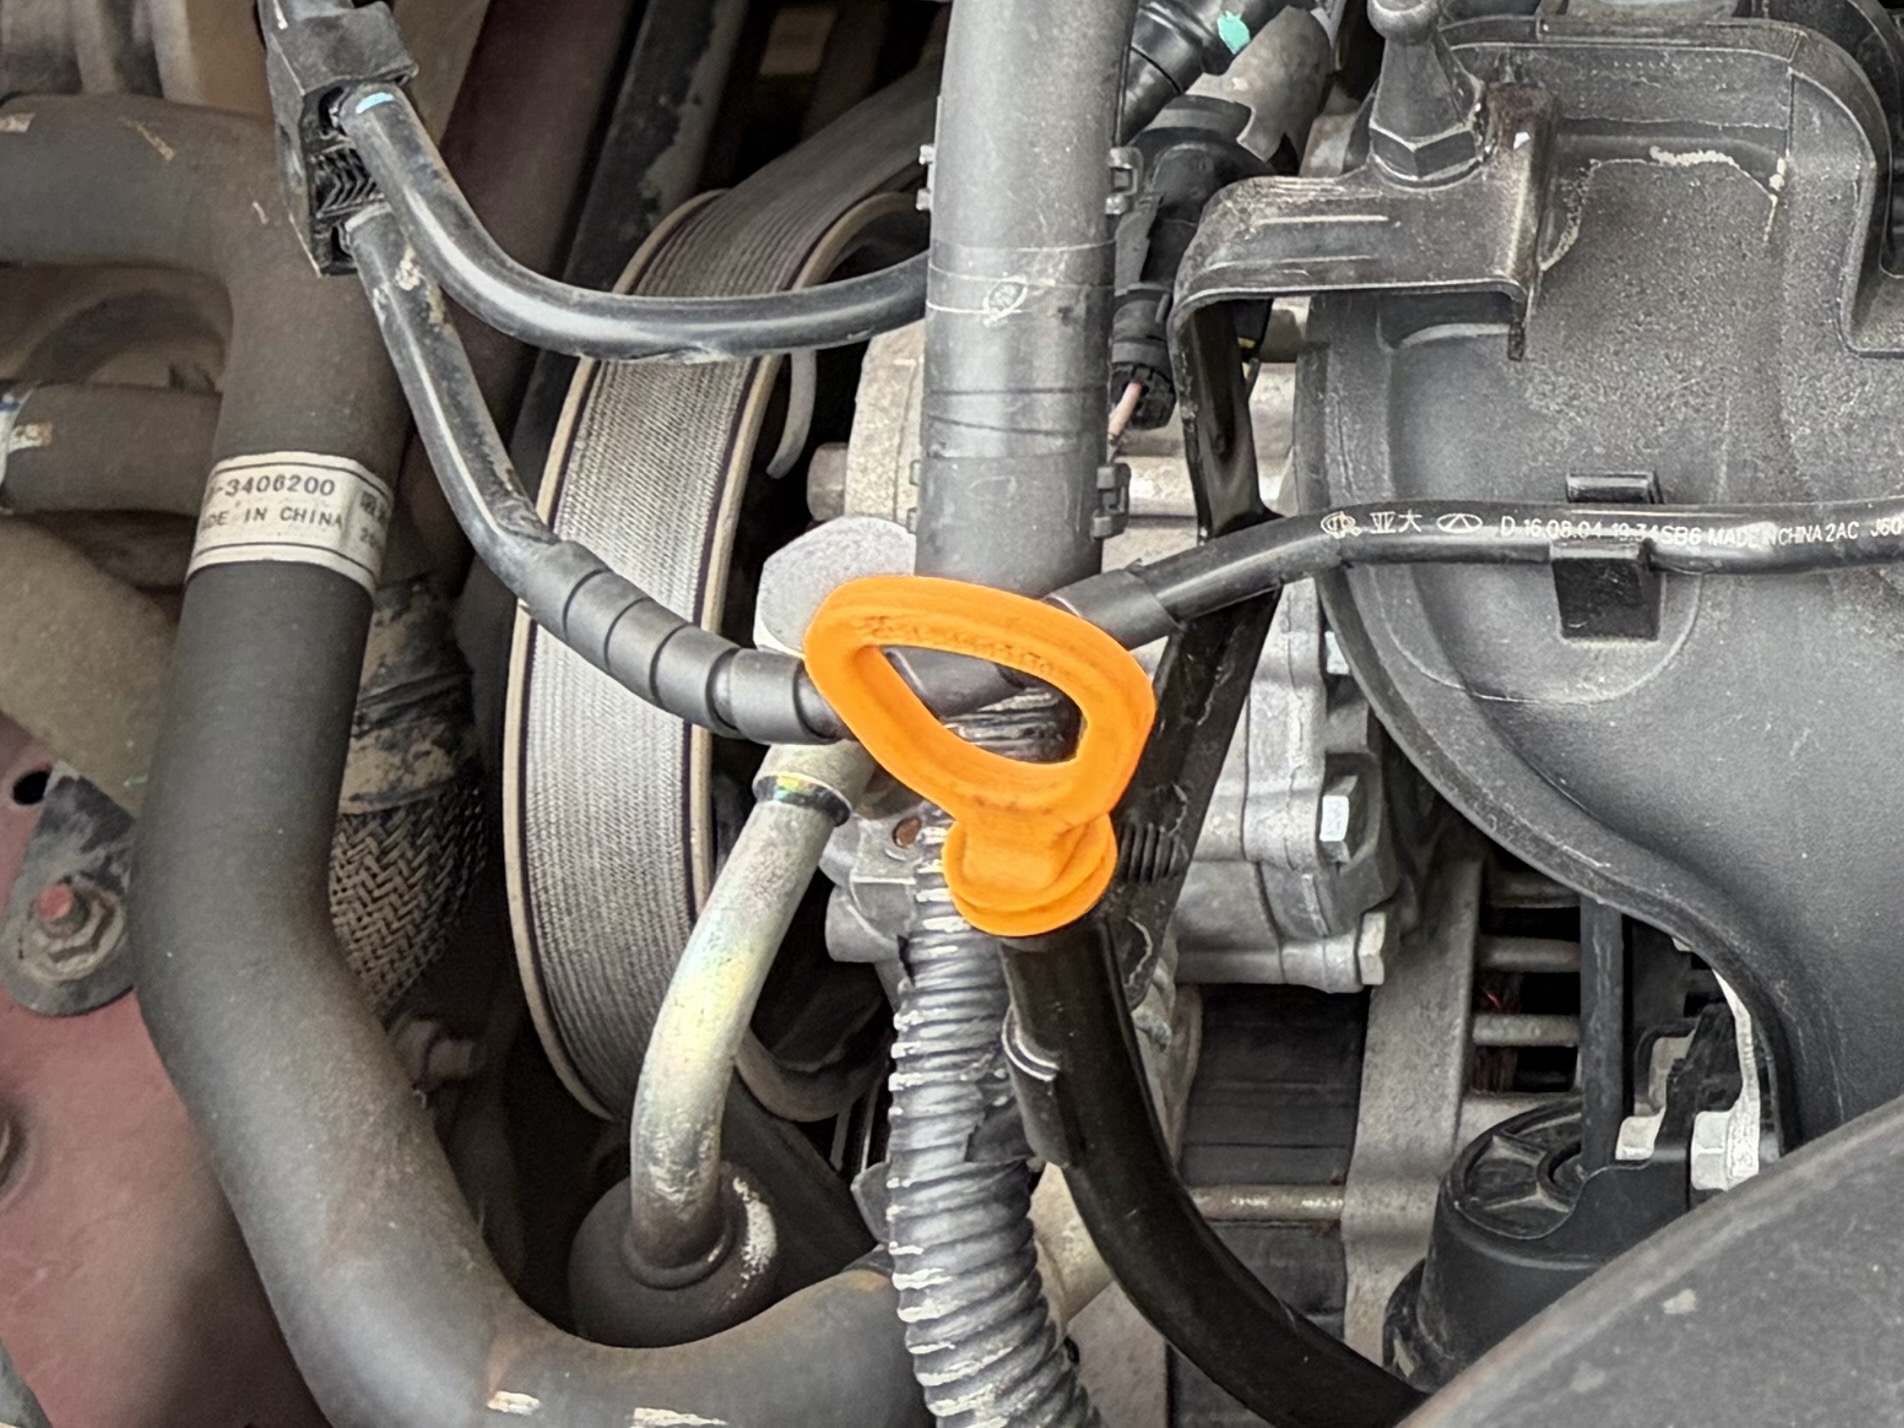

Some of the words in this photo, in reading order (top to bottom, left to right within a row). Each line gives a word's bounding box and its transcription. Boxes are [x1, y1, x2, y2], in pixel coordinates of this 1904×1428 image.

[244, 508, 268, 523] IN
[280, 506, 342, 526] CHINA
[1370, 509, 1423, 534] 亚大
[1501, 516, 1516, 537] D
[1708, 526, 1758, 548] MADE
[1778, 526, 1823, 546] CHINA
[1825, 522, 1860, 544] 2AC
